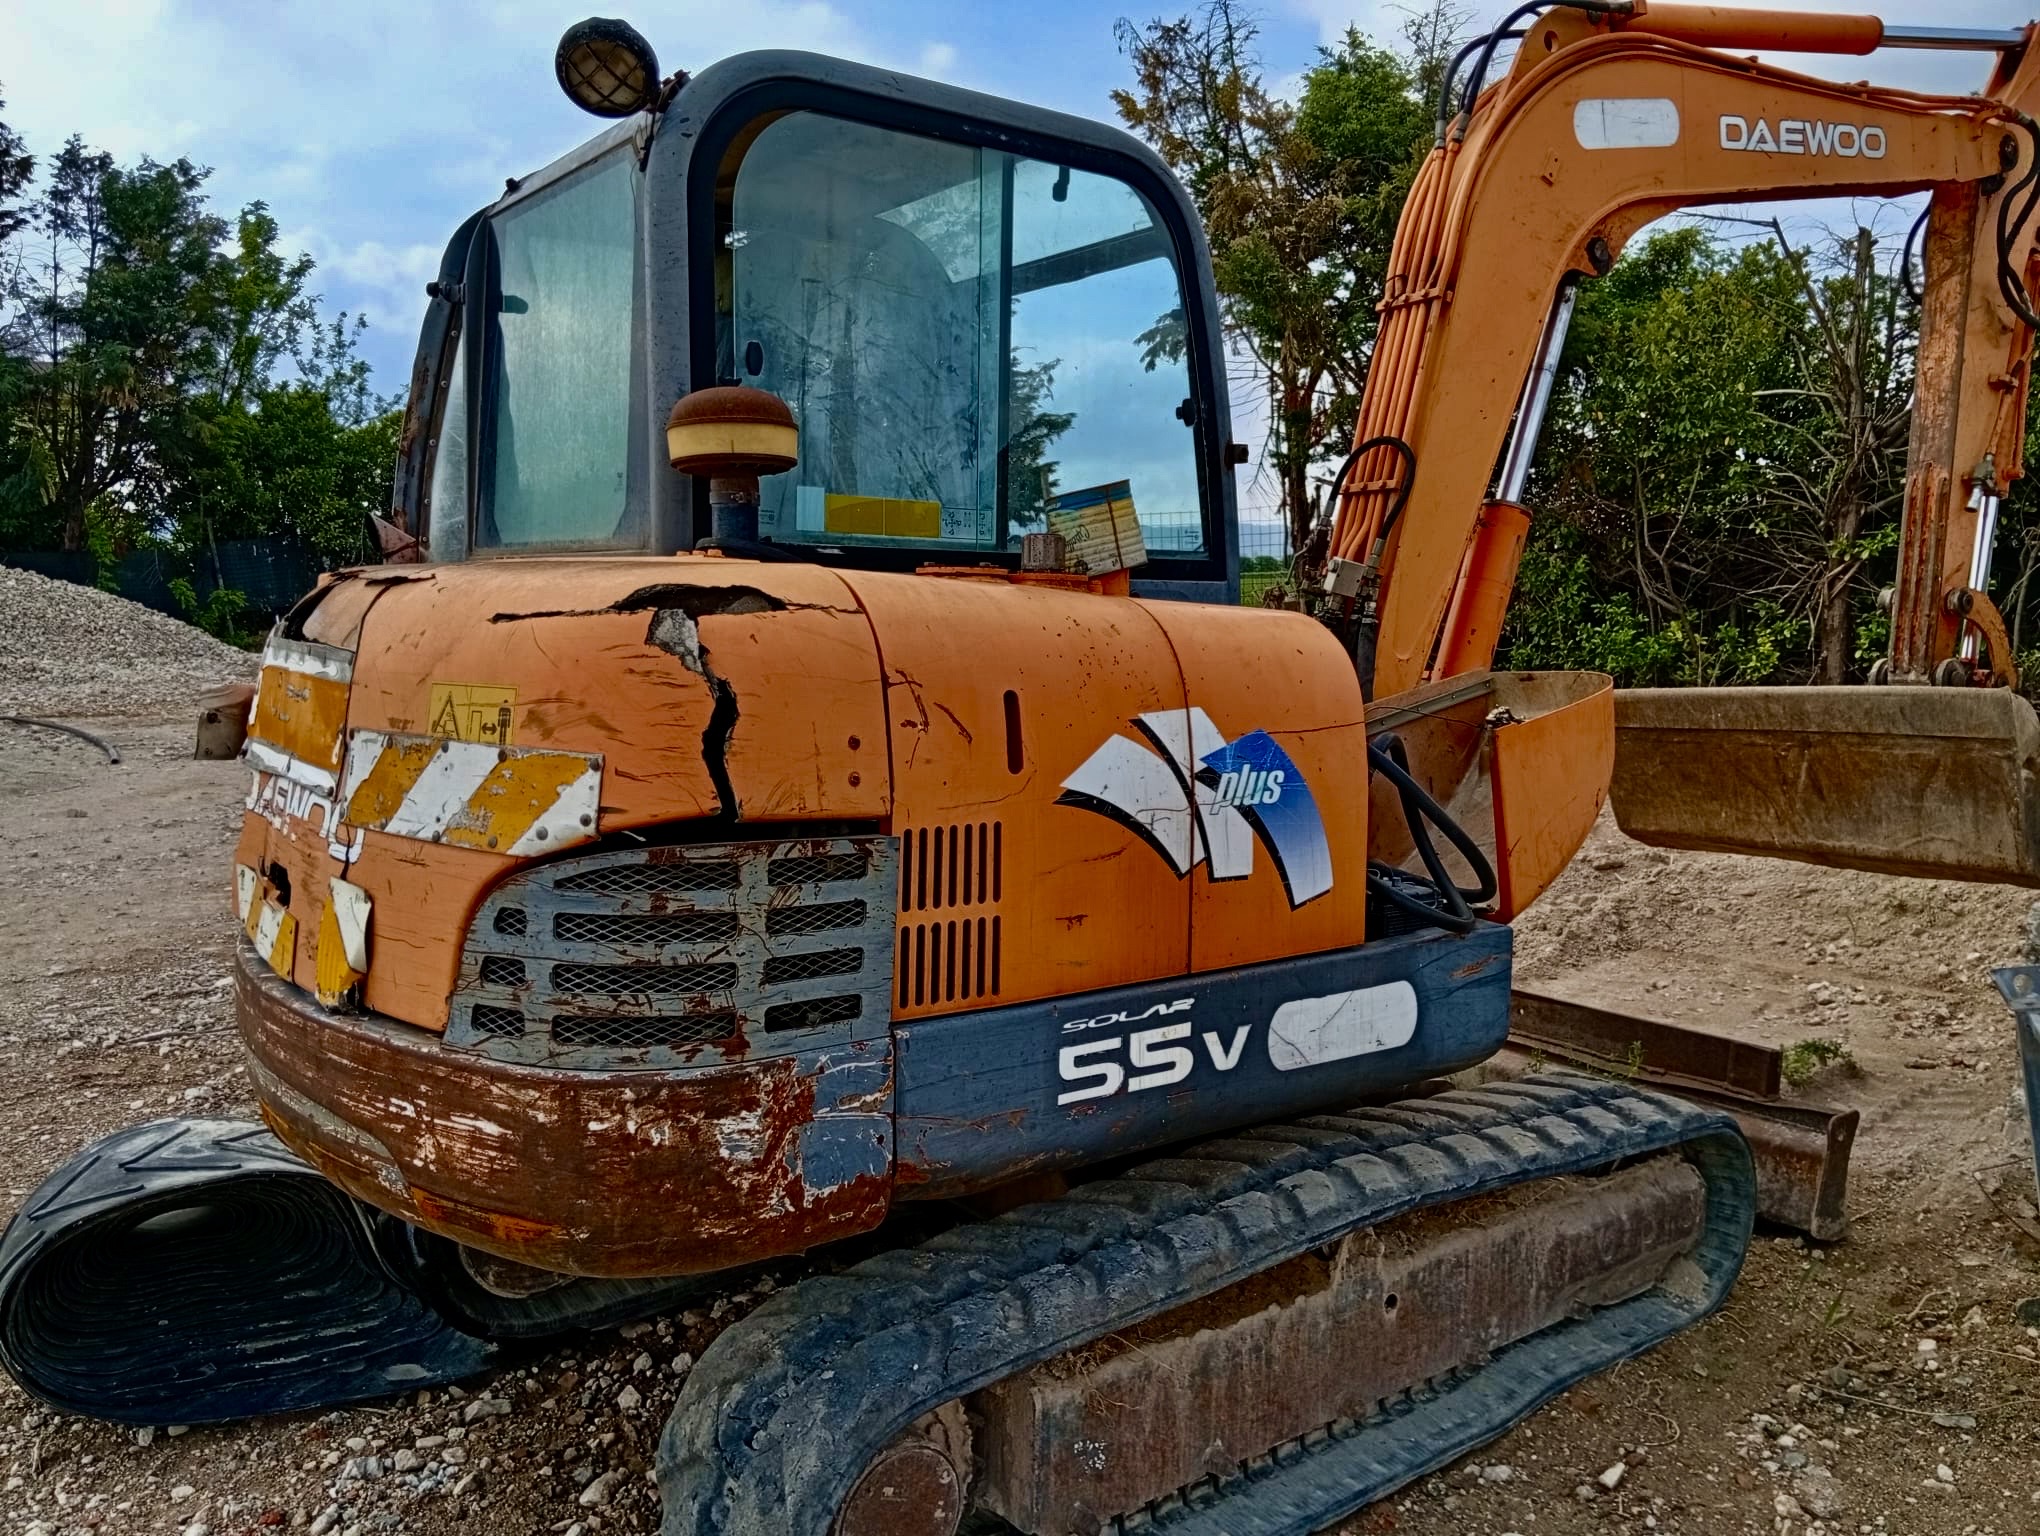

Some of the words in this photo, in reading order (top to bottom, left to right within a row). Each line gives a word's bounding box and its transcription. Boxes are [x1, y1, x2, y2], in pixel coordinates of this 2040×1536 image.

[1719, 114, 1887, 159] DAEWOO
[1209, 764, 1285, 815] plus
[1061, 998, 1196, 1034] SOLAR
